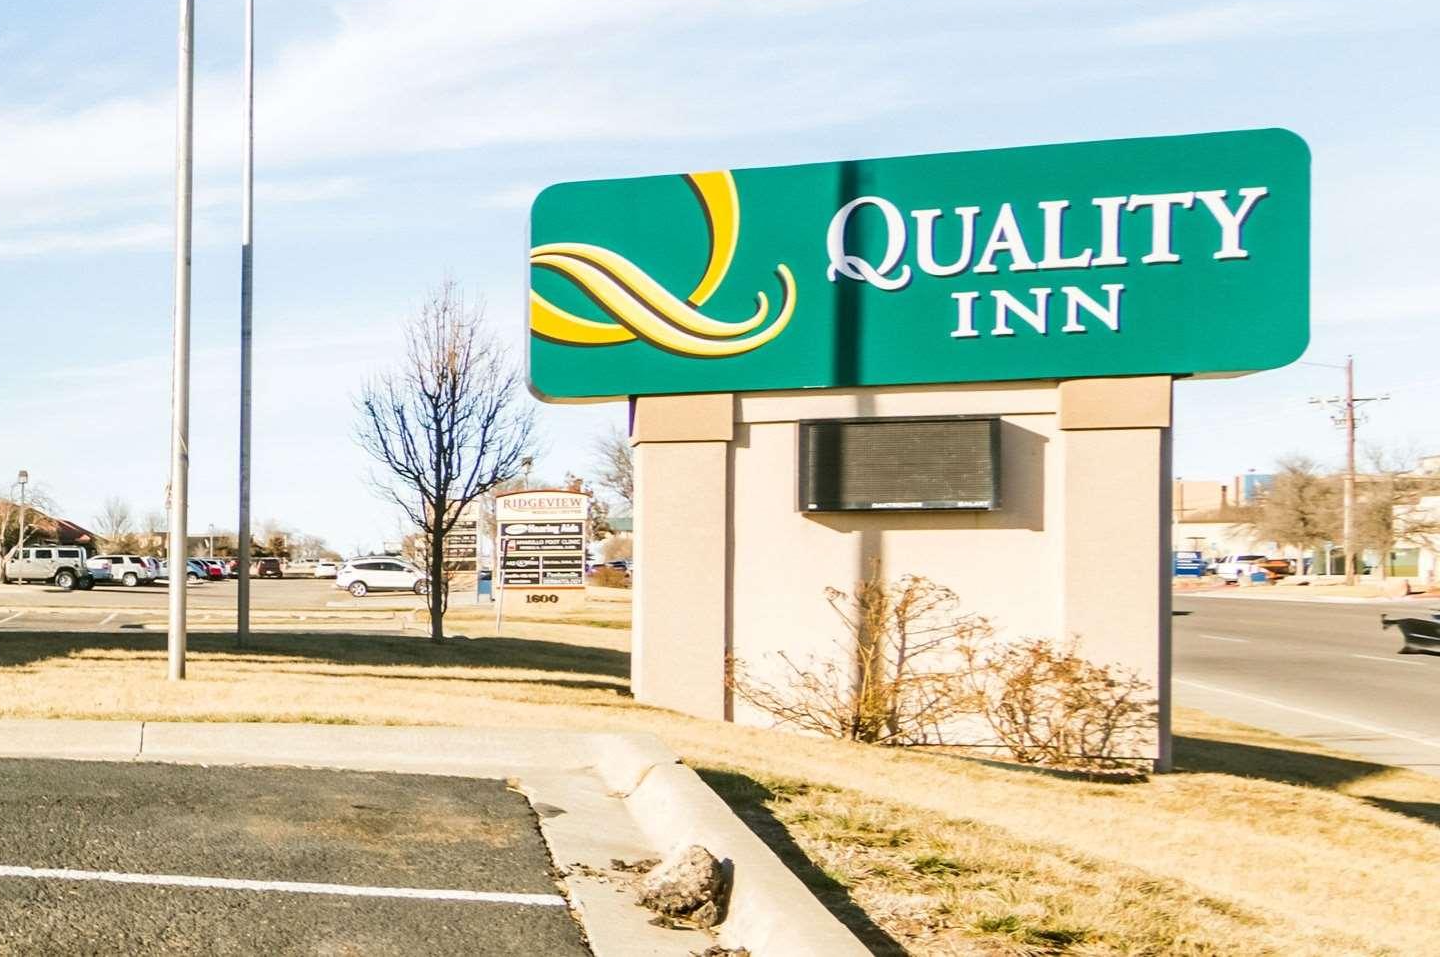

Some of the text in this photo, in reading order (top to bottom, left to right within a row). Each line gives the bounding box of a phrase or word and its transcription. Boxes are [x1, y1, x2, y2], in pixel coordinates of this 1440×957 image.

[826, 186, 1268, 291] QUALITY
[950, 283, 1125, 338] INN
[503, 497, 582, 509] RIDGEVIEW
